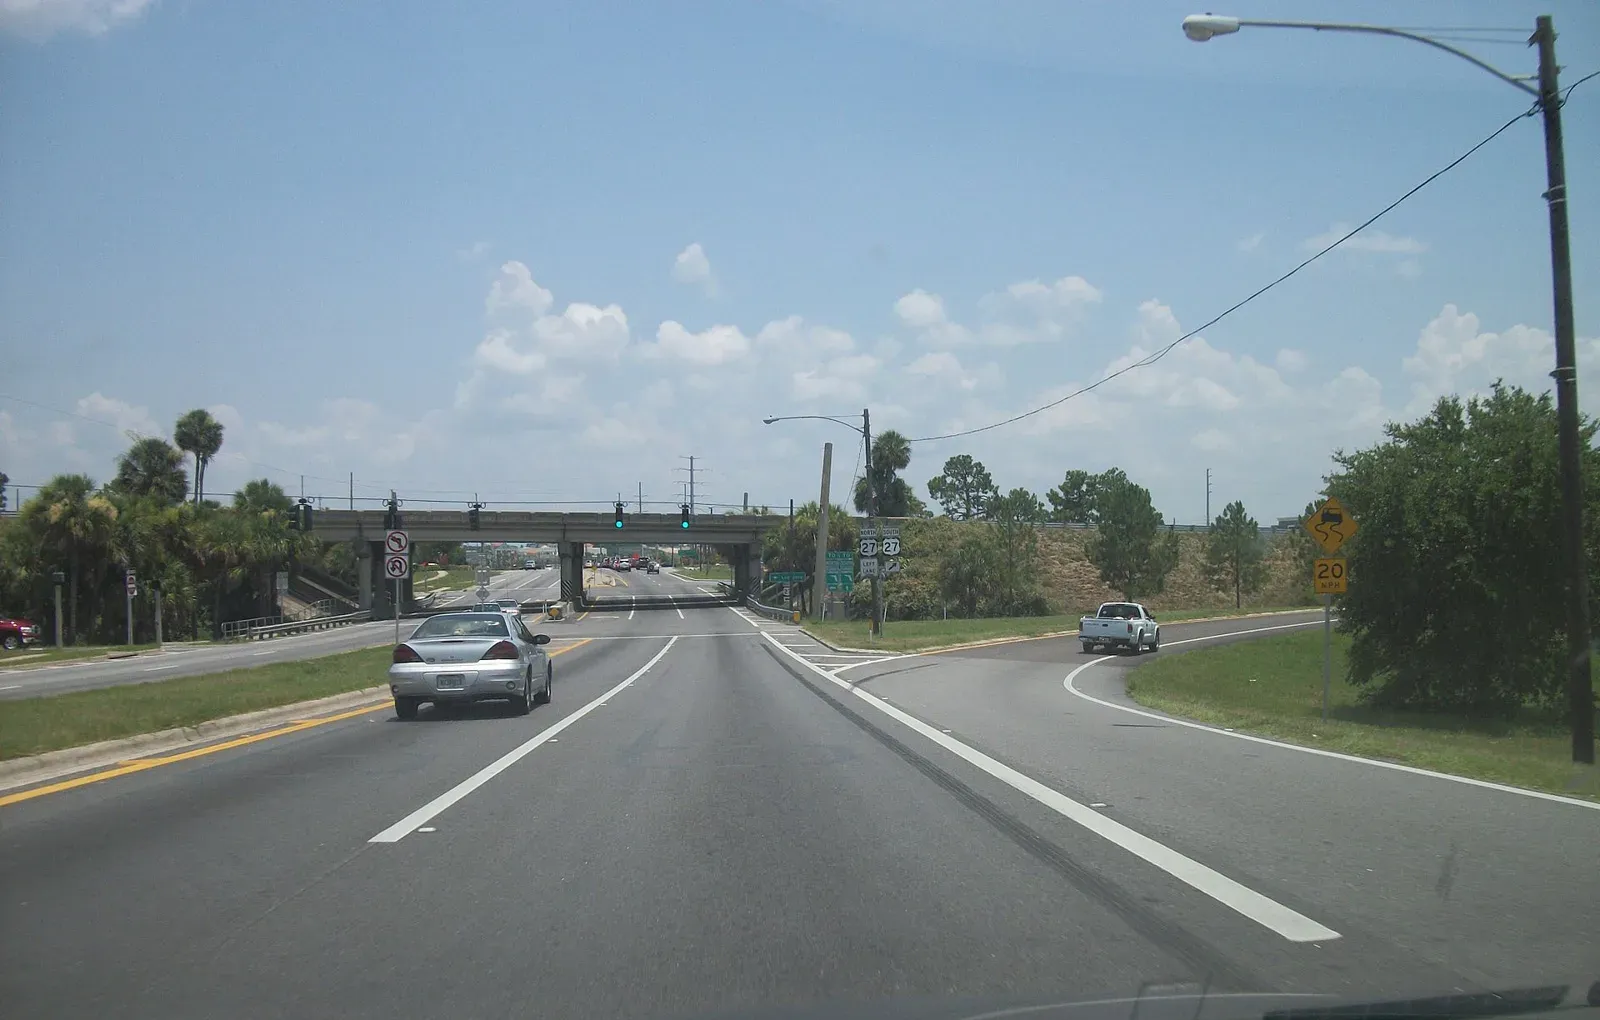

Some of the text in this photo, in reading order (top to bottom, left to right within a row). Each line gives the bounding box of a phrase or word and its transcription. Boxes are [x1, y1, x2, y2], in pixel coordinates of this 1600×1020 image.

[862, 543, 876, 553] 27
[884, 542, 898, 552] 27
[1318, 563, 1343, 579] 20
